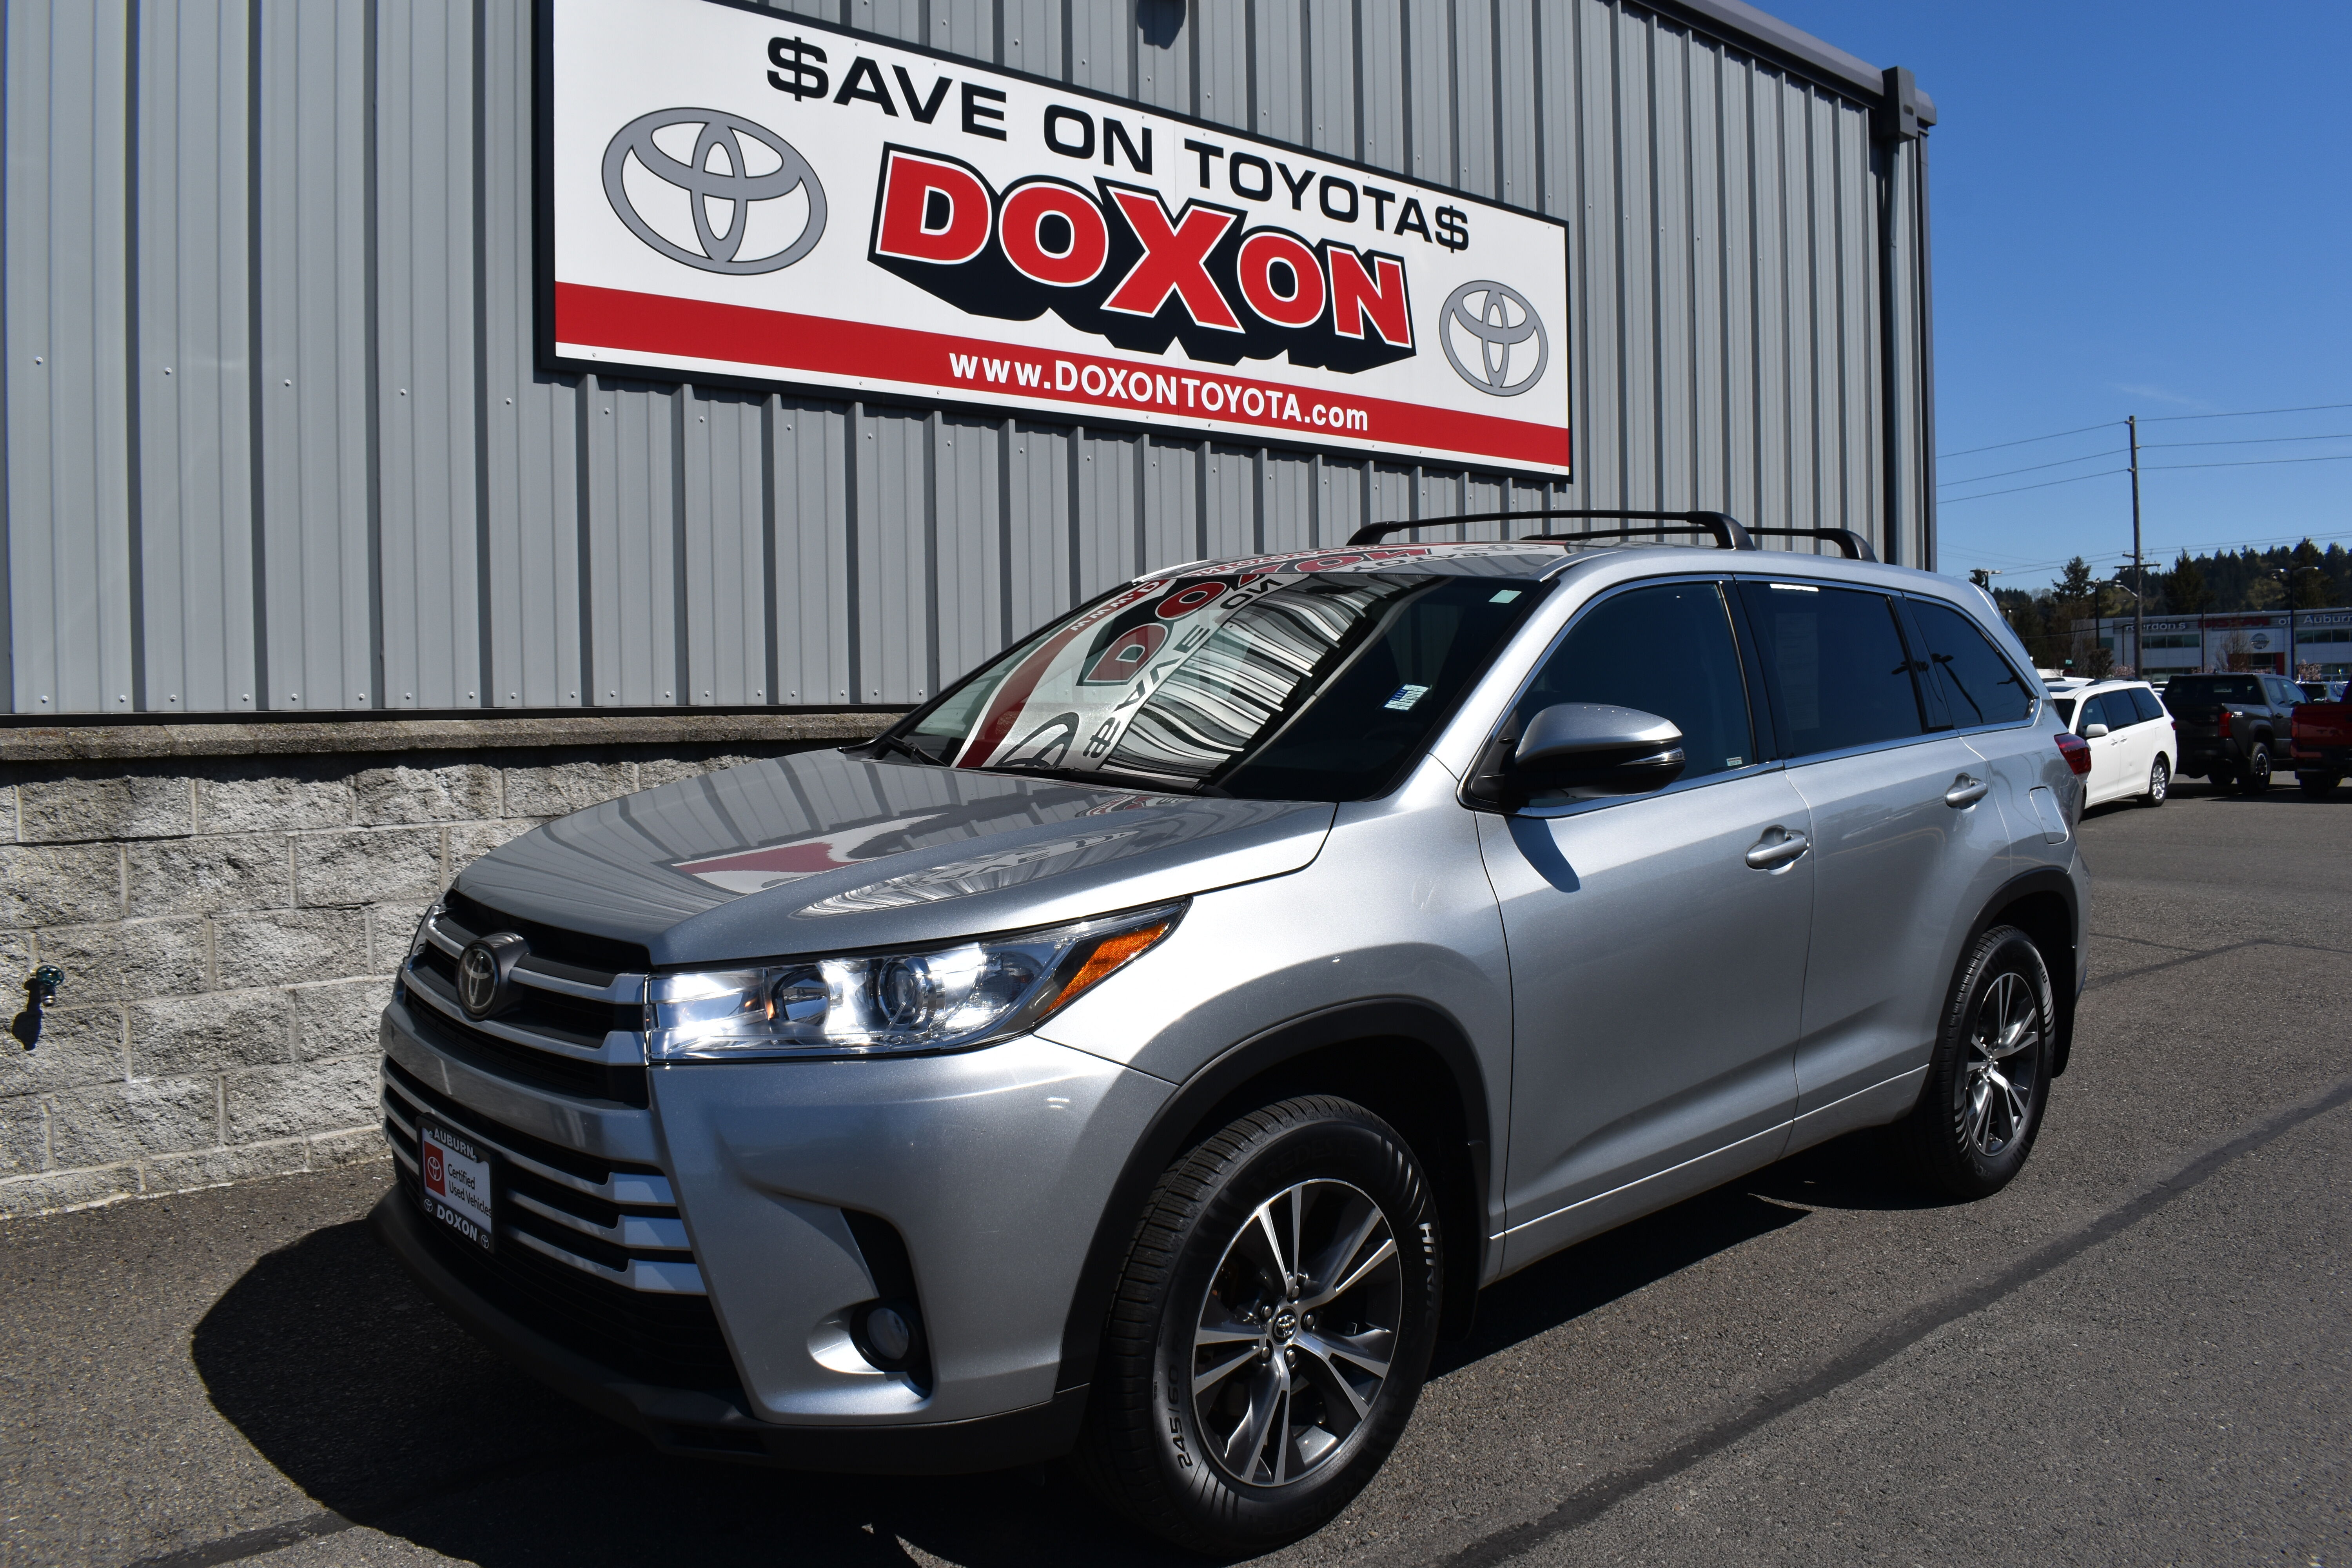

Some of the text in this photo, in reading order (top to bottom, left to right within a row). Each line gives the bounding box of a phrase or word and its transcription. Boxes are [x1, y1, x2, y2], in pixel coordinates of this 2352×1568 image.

[766, 36, 1470, 254] $AVE ON TOYOTA$
[873, 144, 1414, 350] DOXON
[948, 352, 1368, 432] www.DOXONTOYOTA.com
[2278, 616, 2291, 625] of
[434, 1128, 475, 1158] AUBURN
[448, 1163, 475, 1190] Certified
[448, 1180, 492, 1218] Used Vehicles
[436, 1204, 478, 1242] DOXON
